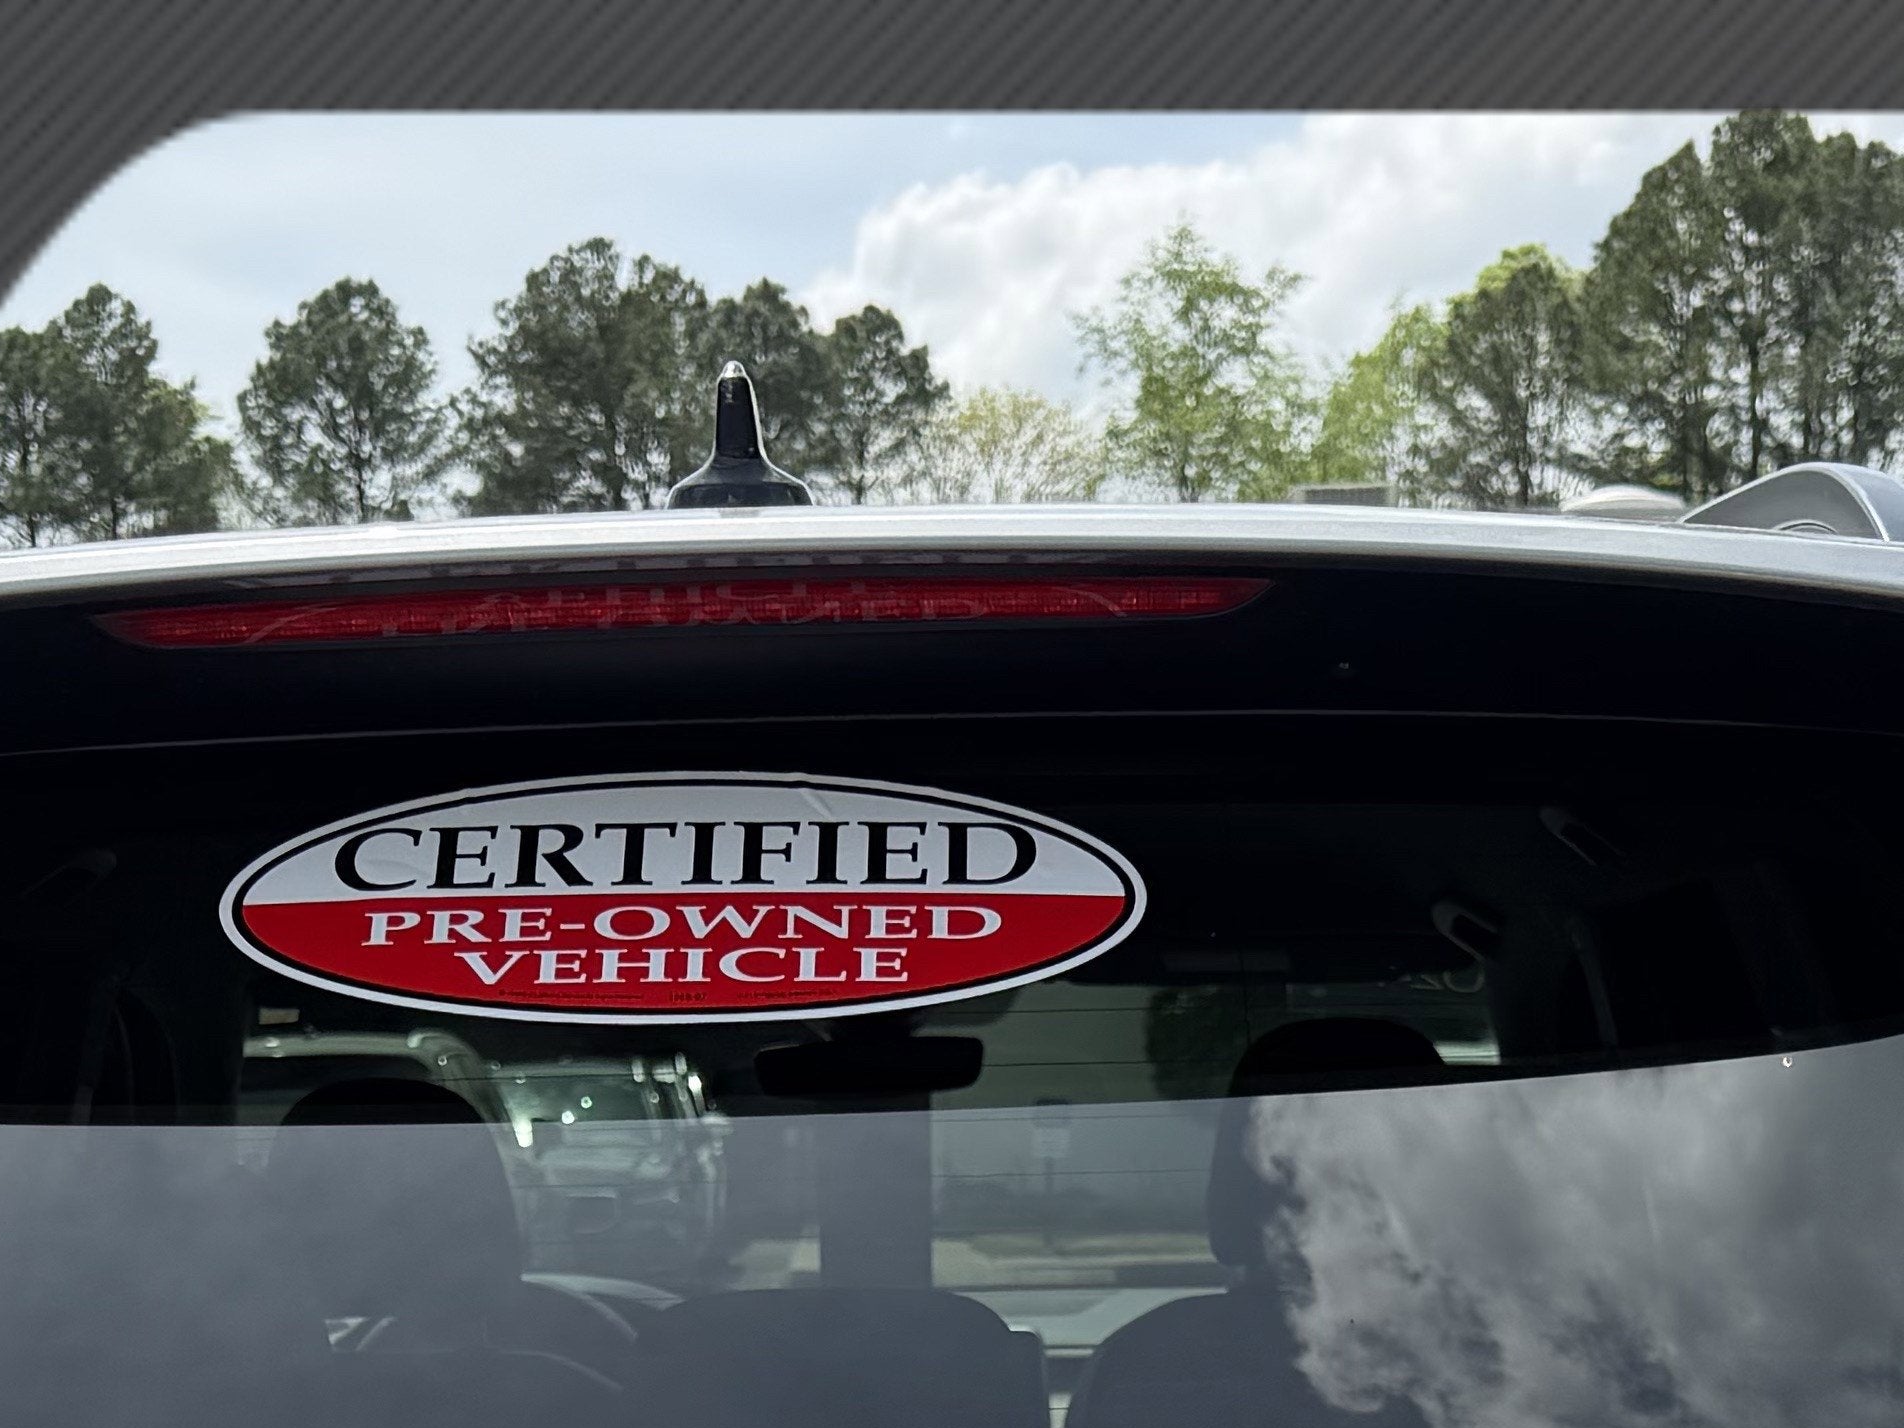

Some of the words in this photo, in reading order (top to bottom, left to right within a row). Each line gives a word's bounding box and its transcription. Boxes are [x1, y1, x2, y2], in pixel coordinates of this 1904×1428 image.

[332, 819, 1040, 893] CERTIFIED
[360, 904, 1003, 948] PRE-OWNED
[452, 946, 910, 986] VEHICLE
